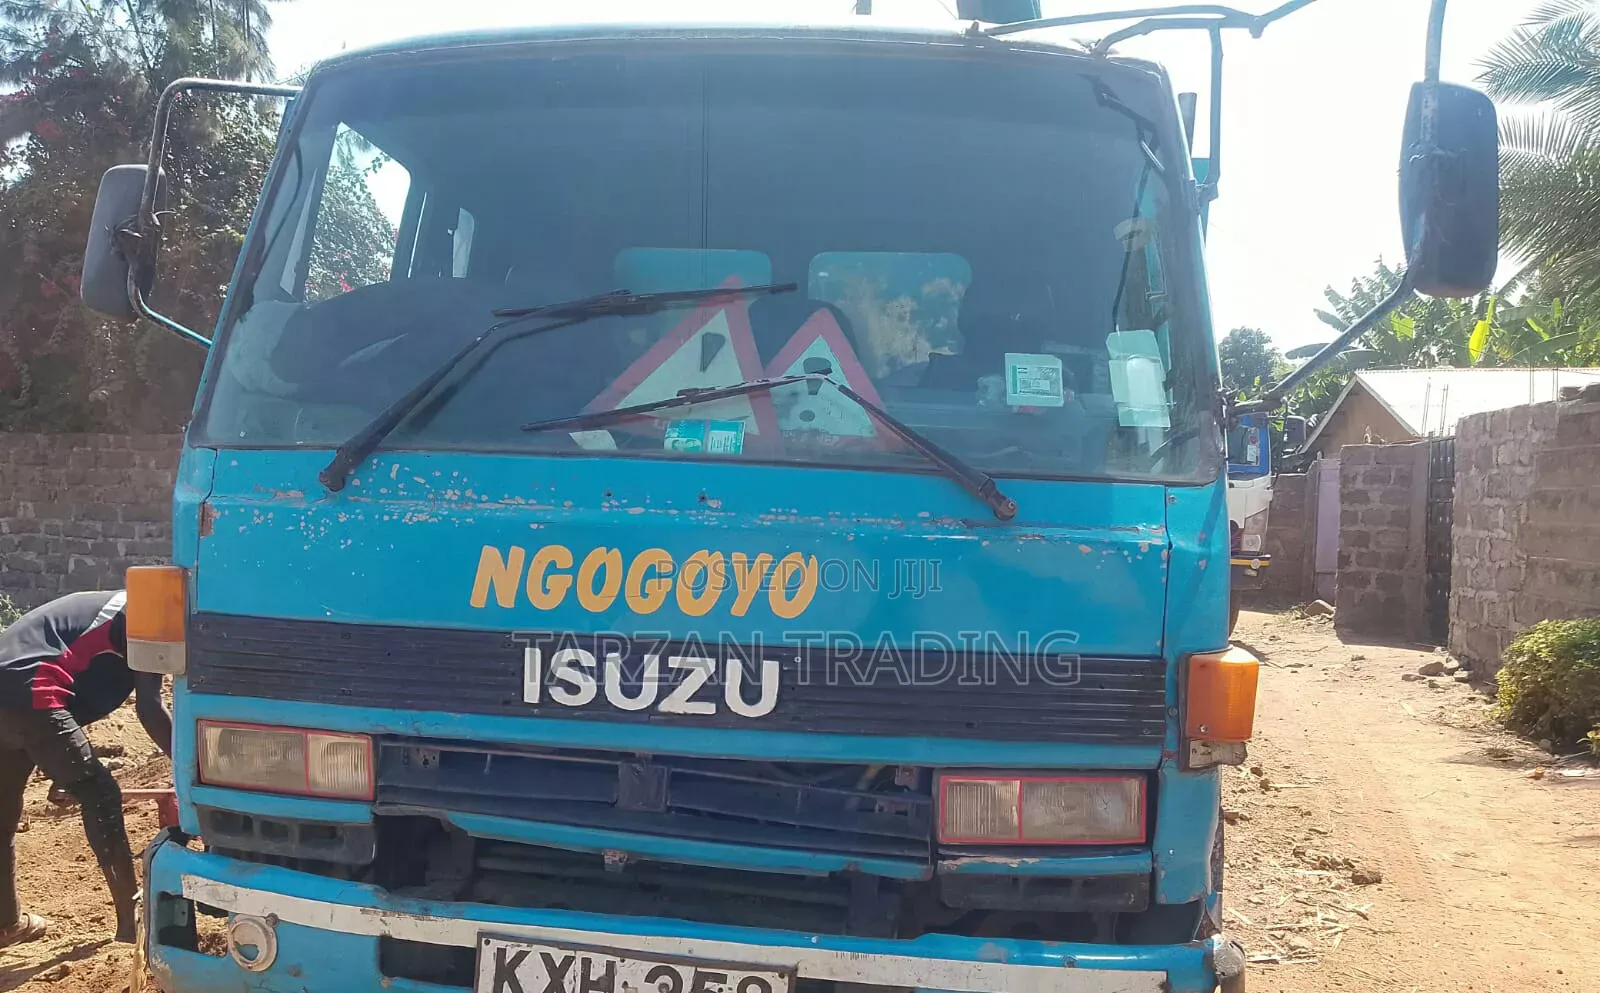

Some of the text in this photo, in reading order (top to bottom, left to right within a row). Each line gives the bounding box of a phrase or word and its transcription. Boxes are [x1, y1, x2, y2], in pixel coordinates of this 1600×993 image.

[470, 545, 818, 619] NGOGOYO
[523, 647, 780, 718] ISUZU
[493, 947, 616, 993] KXH
